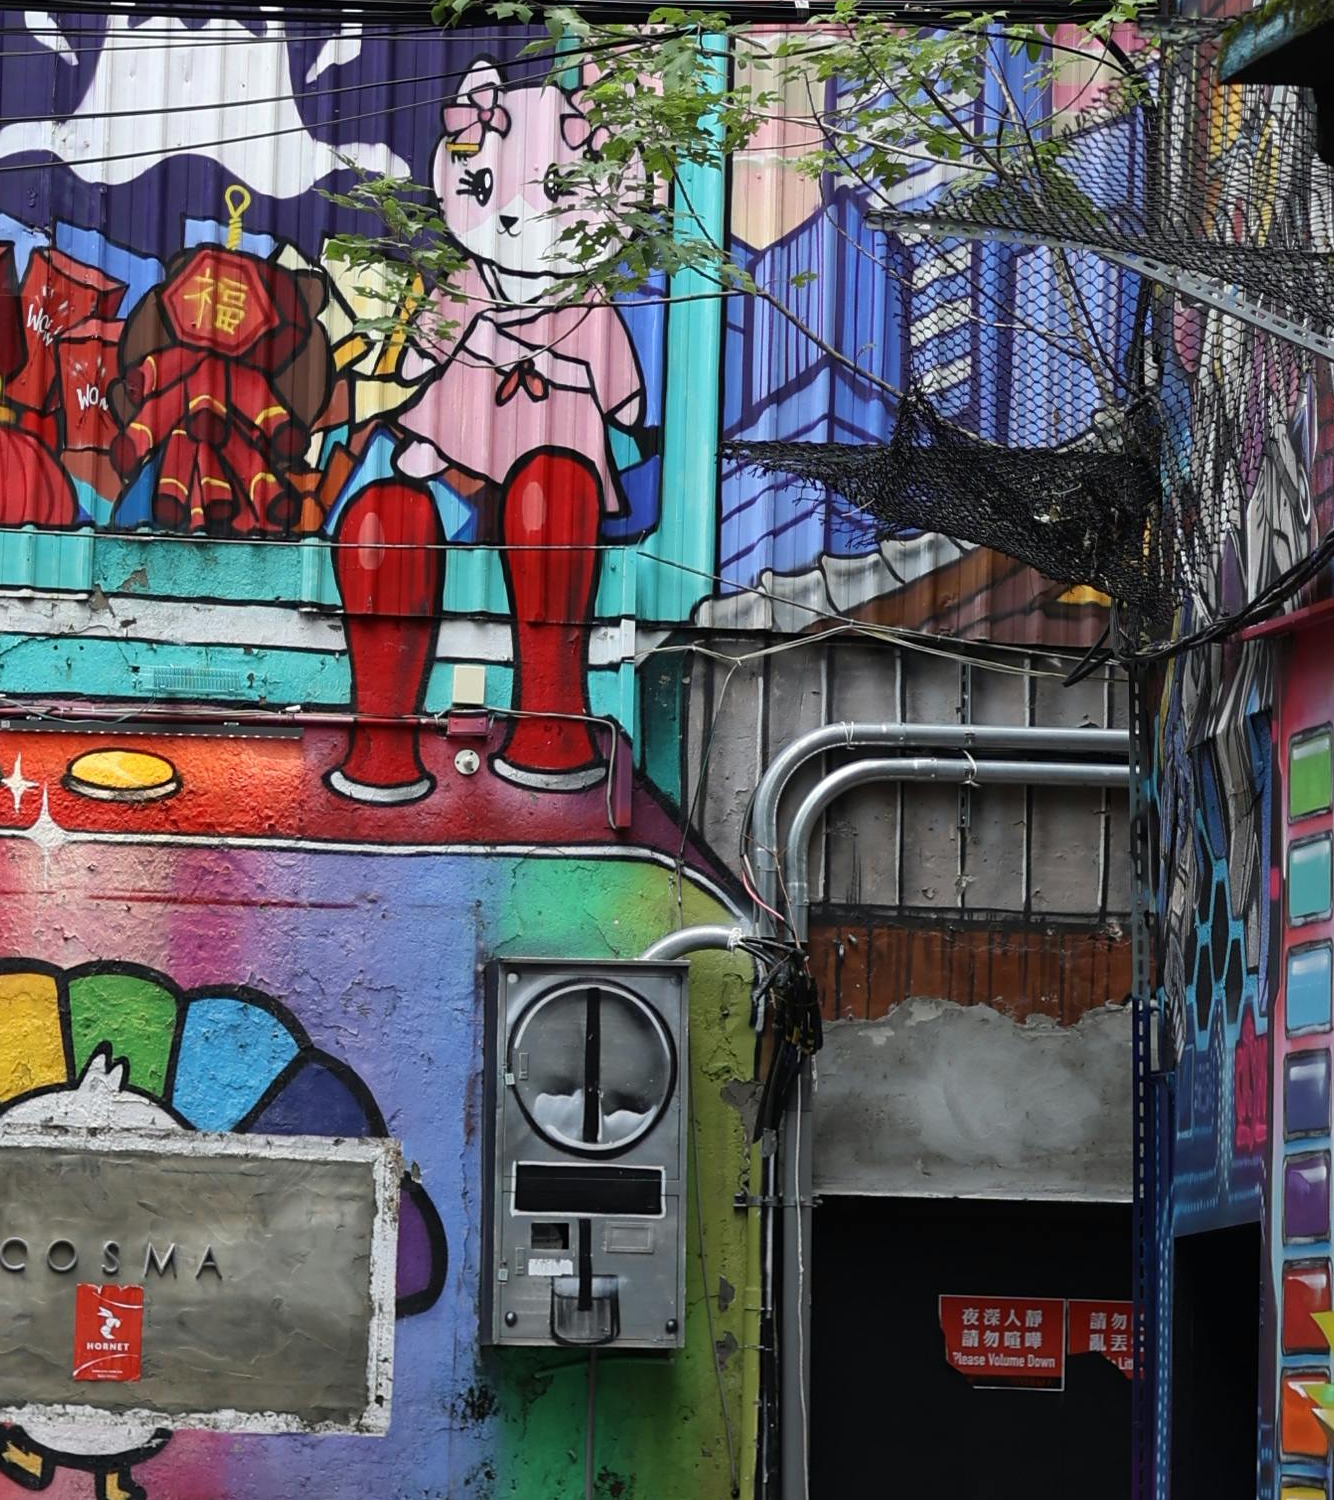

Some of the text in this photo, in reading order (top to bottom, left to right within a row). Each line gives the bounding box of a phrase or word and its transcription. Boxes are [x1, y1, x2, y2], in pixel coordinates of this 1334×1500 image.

[183, 268, 248, 335] 福
[962, 1308, 1043, 1328] 夜深人靜
[86, 1342, 130, 1352] HORNET
[1089, 1333, 1133, 1352] 亂丟
[988, 1353, 1025, 1368] Volume
[1028, 1354, 1056, 1369] Down
